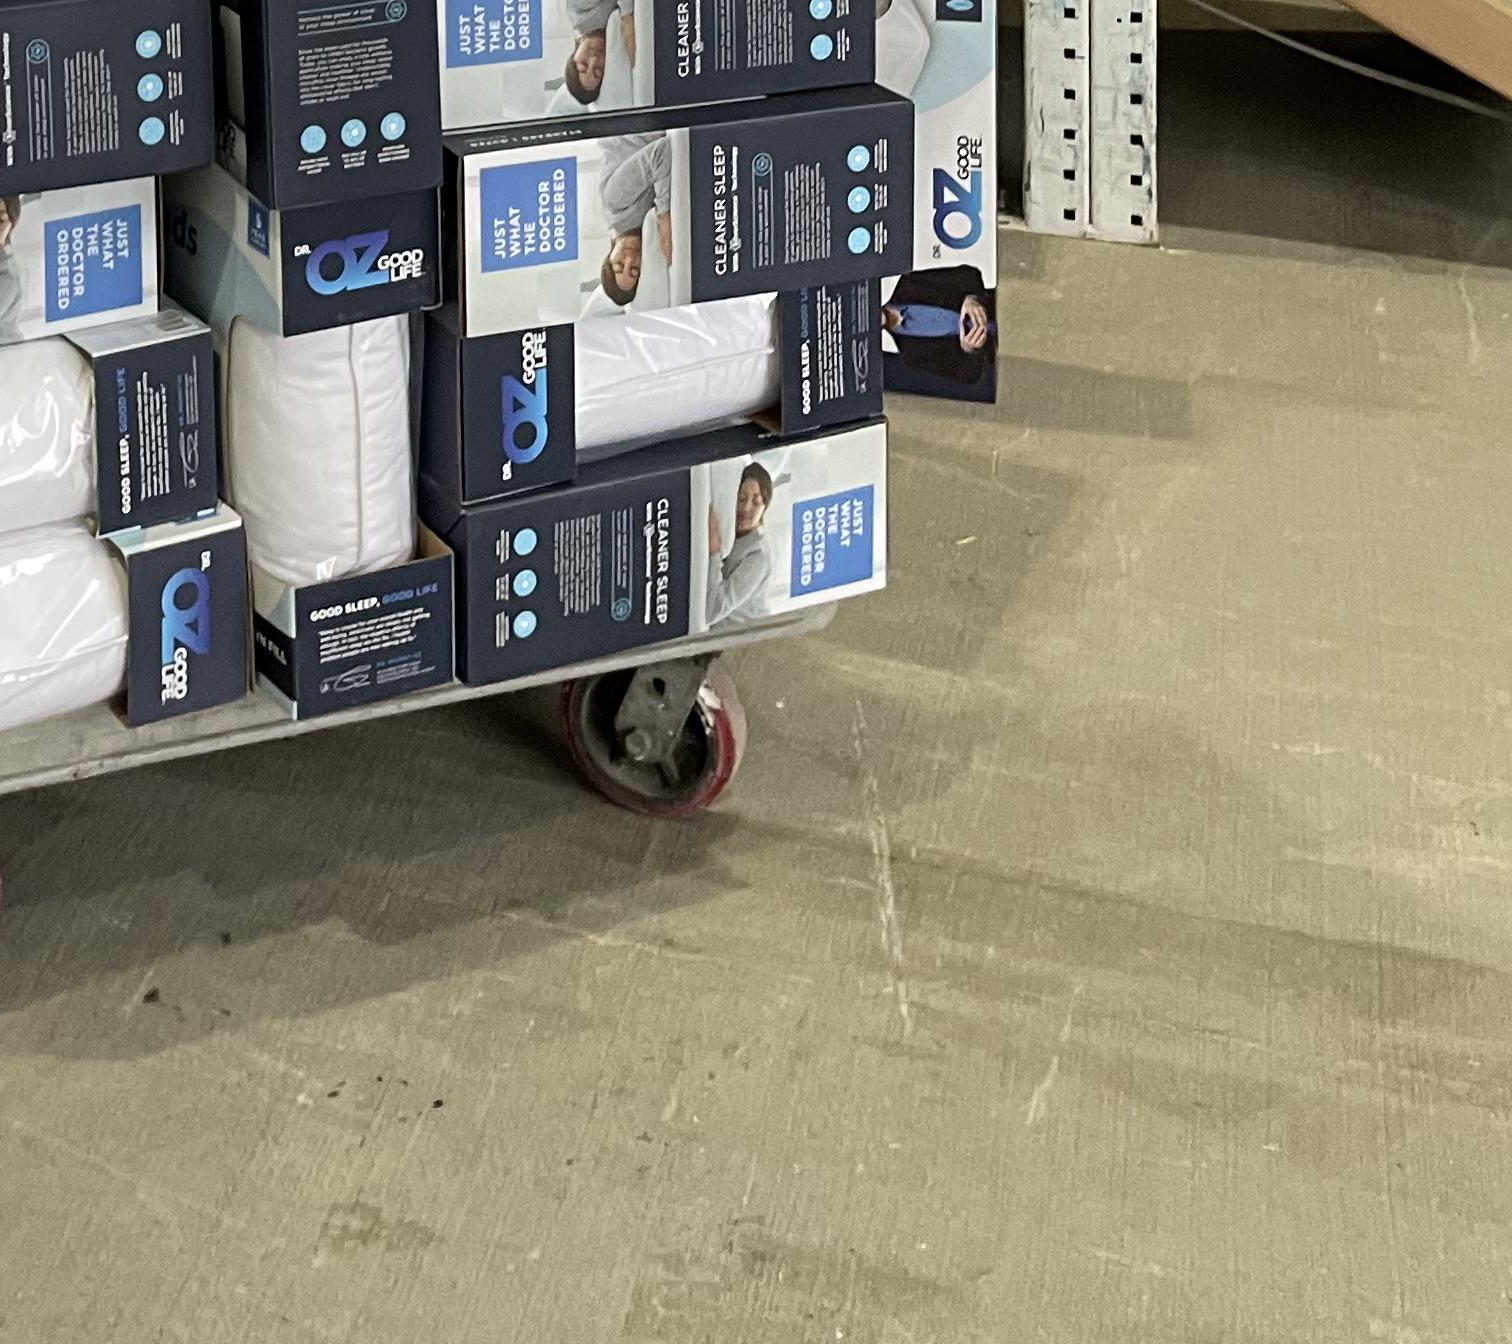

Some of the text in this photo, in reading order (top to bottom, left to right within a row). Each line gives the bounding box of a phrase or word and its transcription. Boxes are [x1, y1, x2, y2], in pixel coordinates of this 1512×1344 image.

[957, 135, 969, 180] GOOD
[970, 137, 982, 168] LIFE
[508, 206, 522, 258] WHAT
[538, 181, 551, 253] DOCTOR
[553, 168, 566, 251] ORDERED
[933, 168, 982, 249] OZ
[305, 229, 389, 295] OZ
[377, 248, 424, 270] GOOD
[493, 218, 506, 259] JUST
[523, 221, 536, 255] THE
[390, 262, 423, 282] LIFE
[656, 498, 669, 624] CLEANER SLEEP
